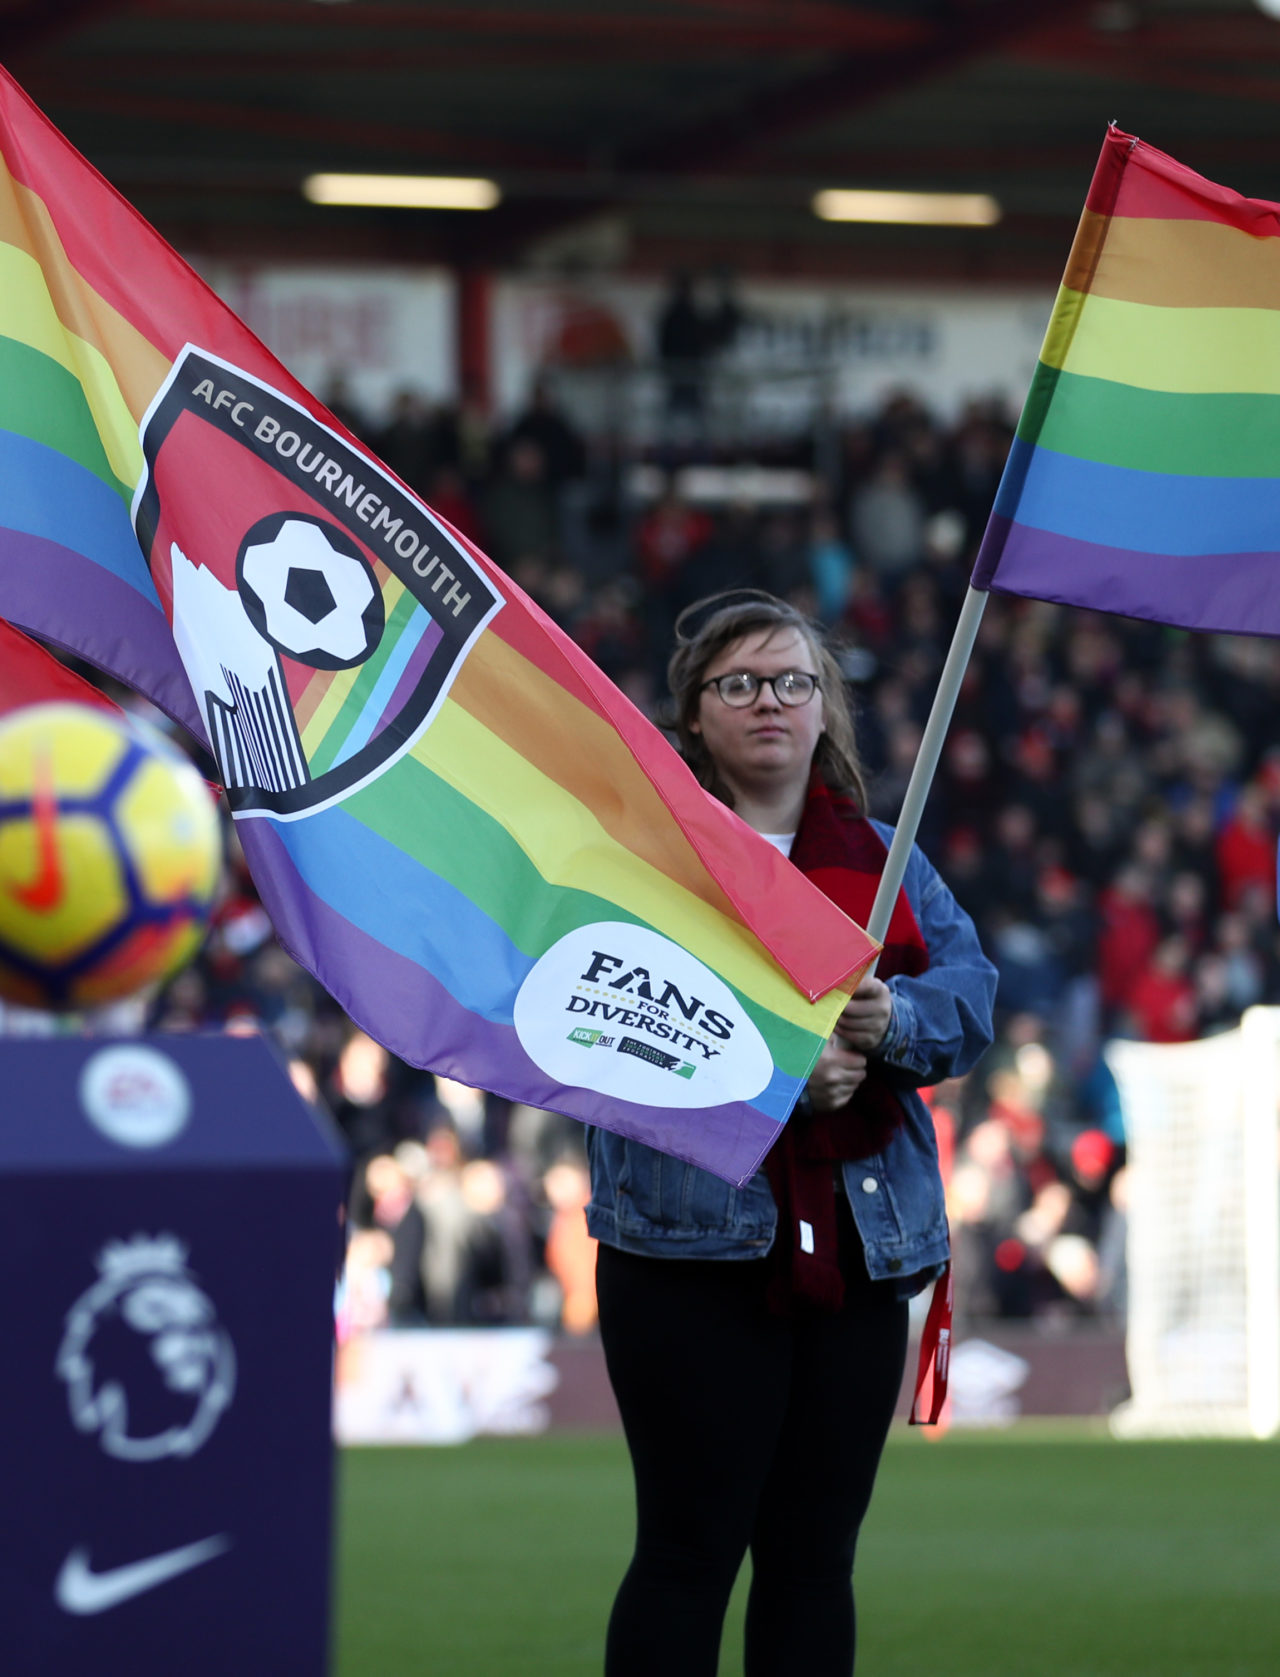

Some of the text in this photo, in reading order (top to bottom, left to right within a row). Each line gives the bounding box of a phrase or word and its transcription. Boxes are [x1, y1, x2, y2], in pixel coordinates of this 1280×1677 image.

[191, 379, 472, 618] AFC BOURNEMOUTH
[565, 995, 721, 1060] DIVERSITY
[580, 950, 735, 1040] FANS
[637, 1001, 670, 1020] FOR
[598, 1034, 616, 1045] OUT
